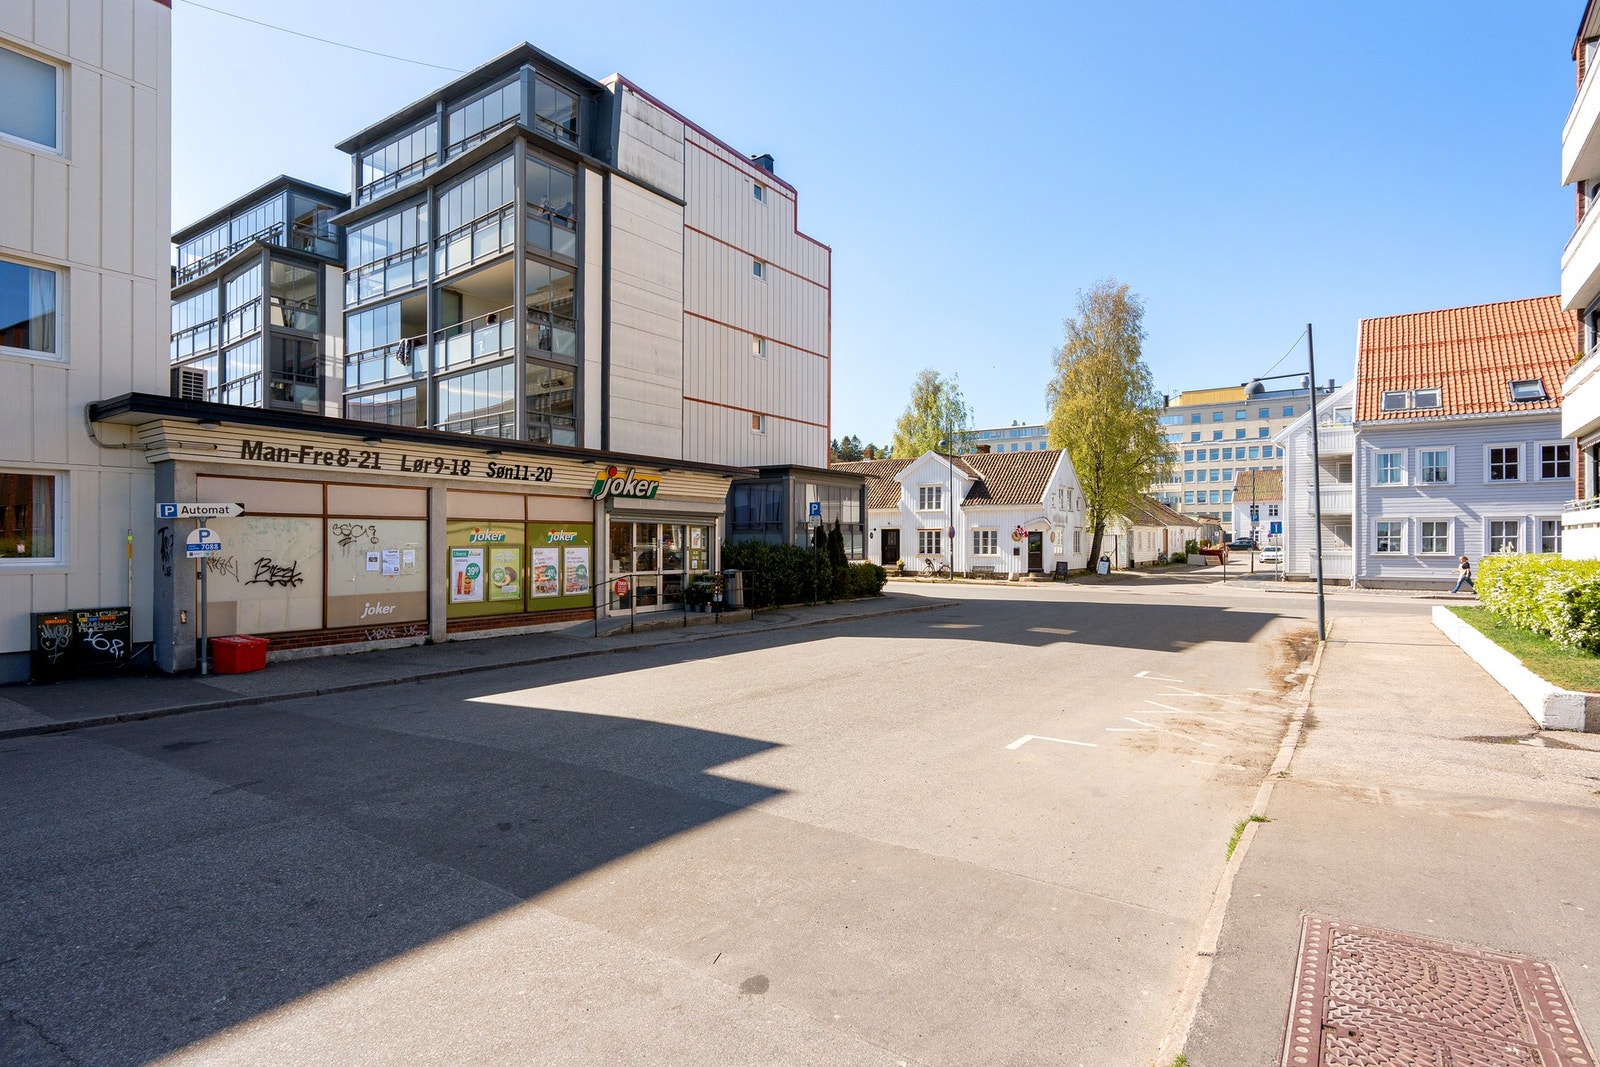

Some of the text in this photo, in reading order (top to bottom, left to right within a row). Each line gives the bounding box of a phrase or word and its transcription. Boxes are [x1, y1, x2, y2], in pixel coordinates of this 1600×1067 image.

[595, 465, 659, 500] joker
[164, 505, 230, 516] P Automat
[811, 504, 818, 514] P
[198, 530, 210, 542] P
[470, 527, 504, 543] joker
[547, 529, 575, 543] joker
[360, 602, 396, 619] joker
